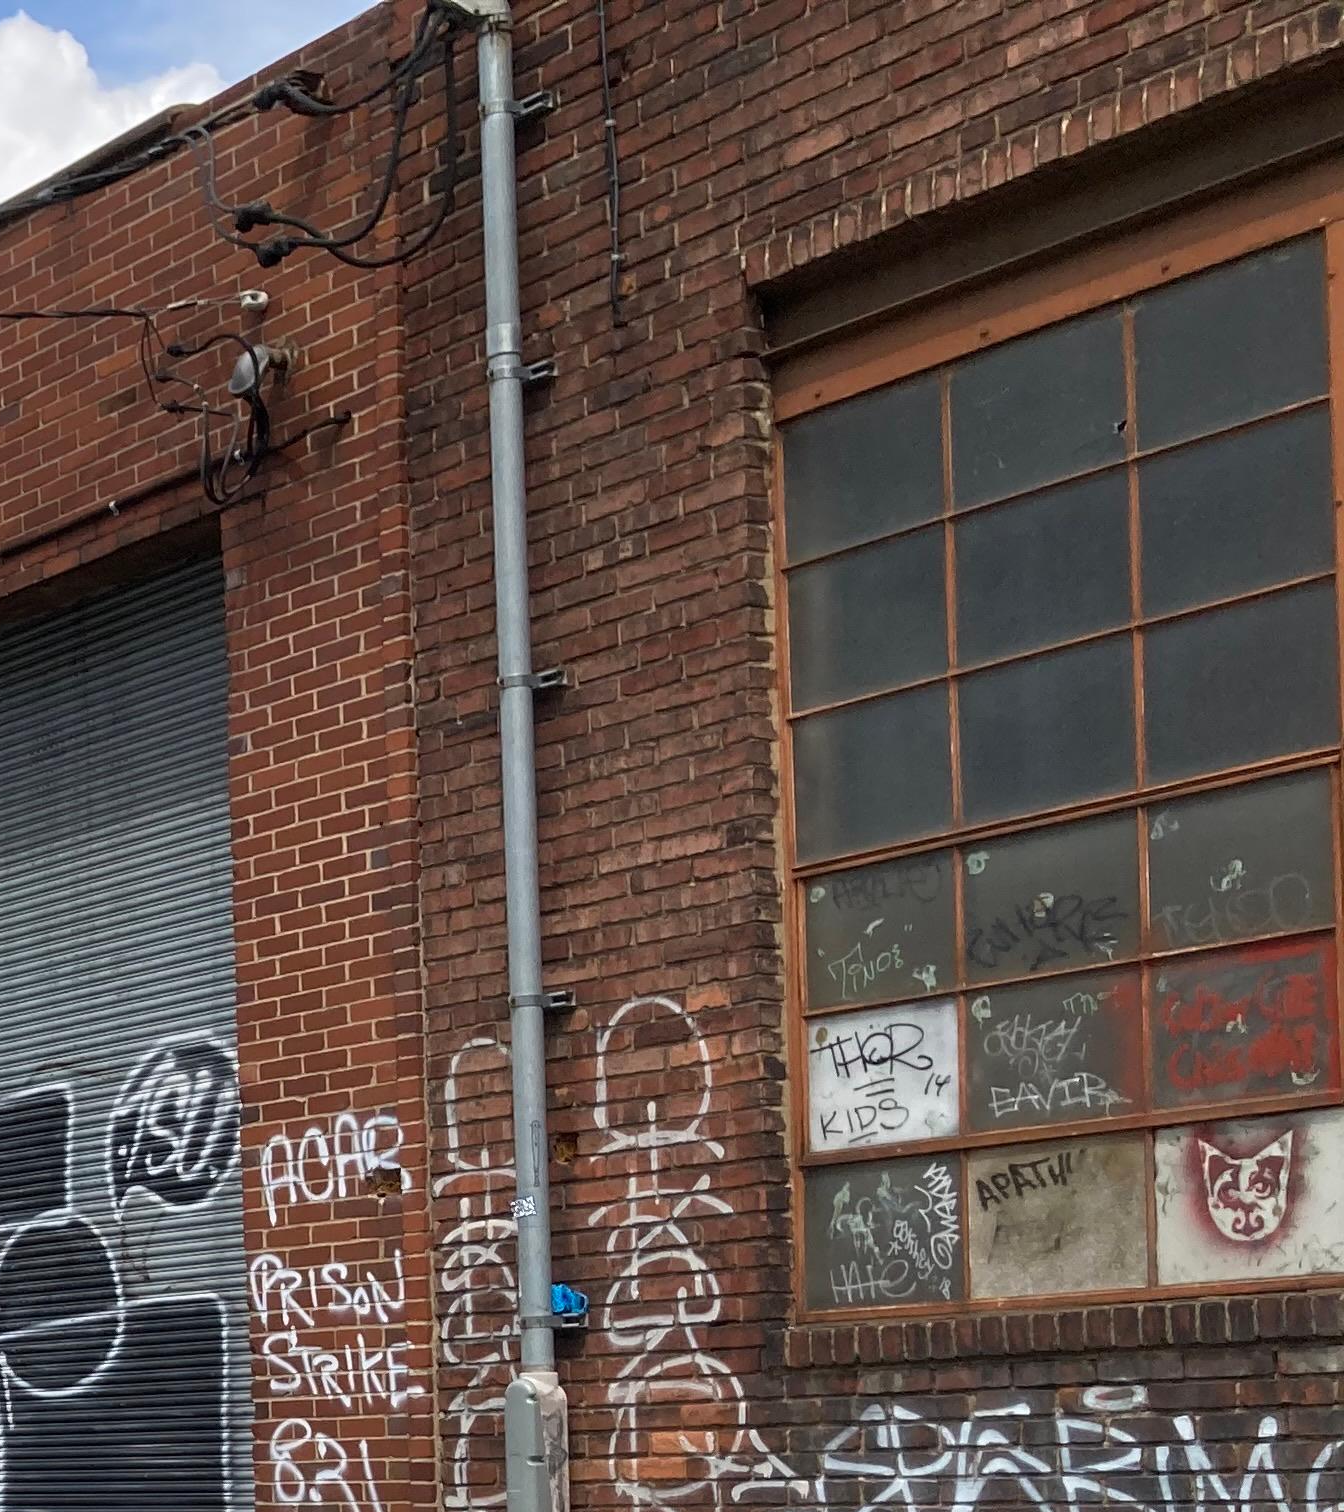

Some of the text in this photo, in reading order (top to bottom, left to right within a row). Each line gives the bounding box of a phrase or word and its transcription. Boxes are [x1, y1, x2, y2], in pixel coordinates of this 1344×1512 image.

[820, 1098, 909, 1140] KIDS
[250, 1249, 405, 1326] PRISON
[263, 1325, 426, 1408] STRIKE
